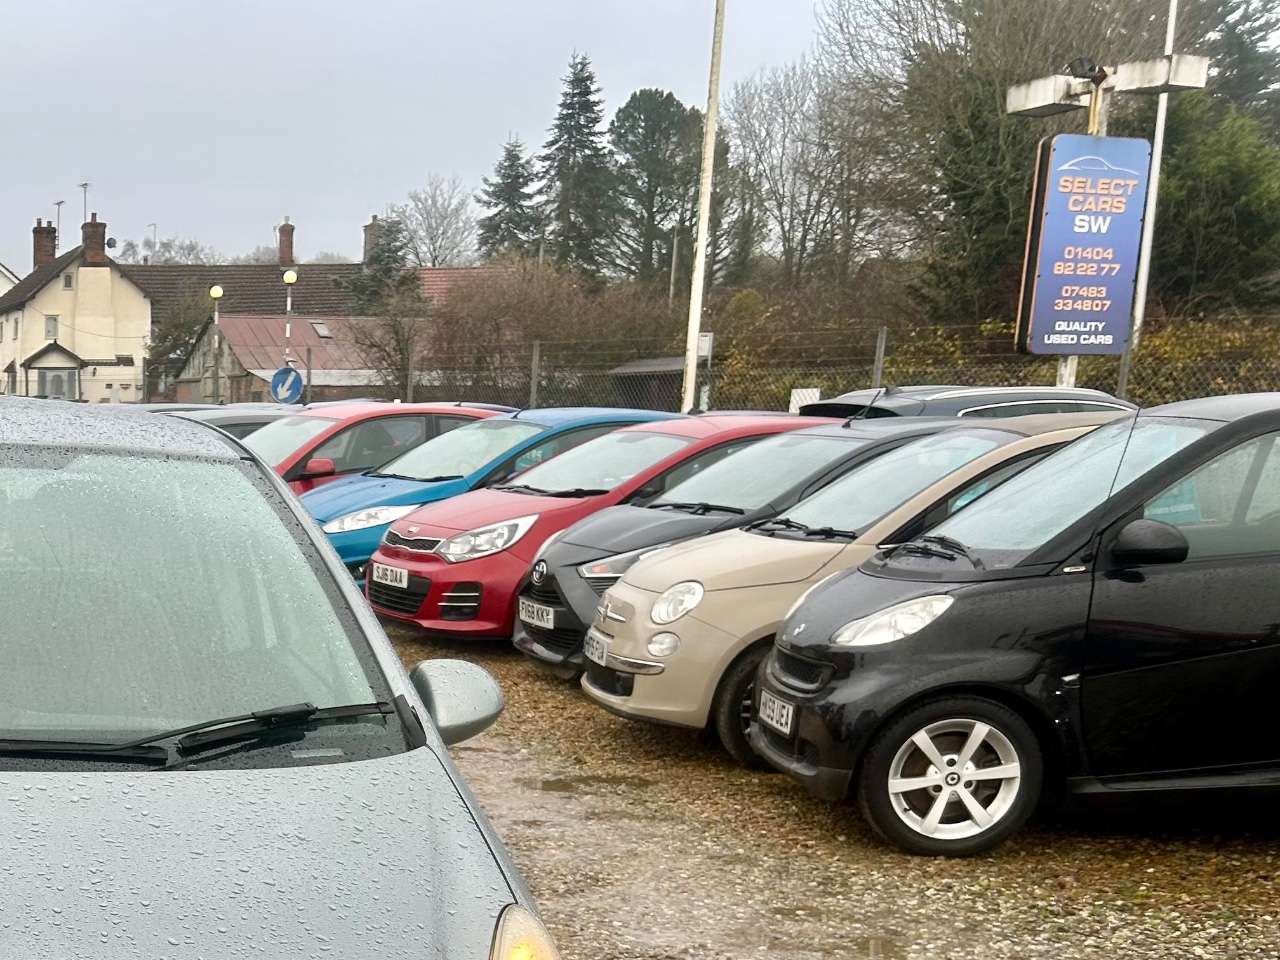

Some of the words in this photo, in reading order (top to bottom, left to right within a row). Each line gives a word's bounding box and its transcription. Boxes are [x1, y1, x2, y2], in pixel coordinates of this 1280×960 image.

[1058, 176, 1138, 196] SELECT
[1068, 196, 1127, 214] CARS
[1073, 215, 1112, 234] SW
[1064, 247, 1114, 260] 01404
[1053, 262, 1073, 275] 82
[1076, 263, 1097, 275] 22
[1100, 264, 1121, 276] 77
[1062, 286, 1106, 298] 07483
[1054, 300, 1111, 311] 334807
[1055, 321, 1106, 331] QUALITY
[1044, 335, 1077, 344] USED
[1080, 335, 1113, 345] CARS
